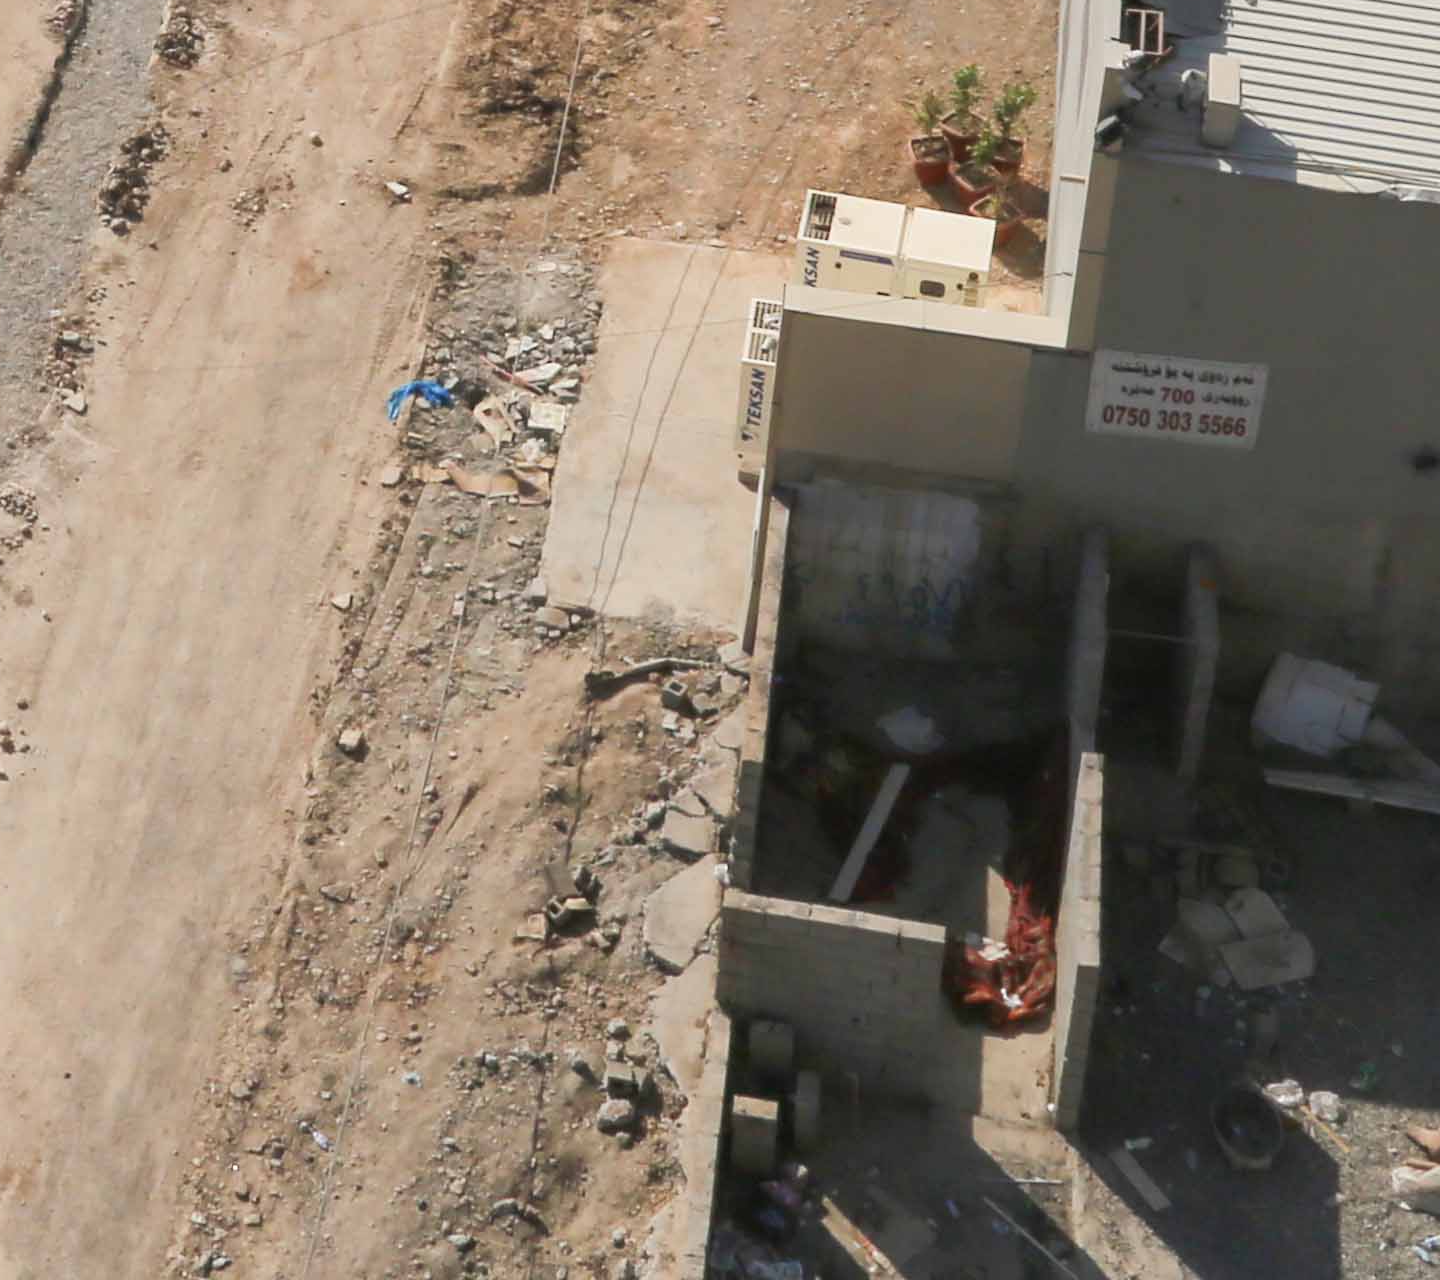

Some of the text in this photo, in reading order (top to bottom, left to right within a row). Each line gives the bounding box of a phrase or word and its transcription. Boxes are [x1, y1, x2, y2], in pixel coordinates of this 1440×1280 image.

[803, 246, 820, 288] KSAN
[746, 368, 766, 428] TEKSAN
[1160, 387, 1195, 404] 700
[1102, 404, 1248, 437] 0750 303 5566
